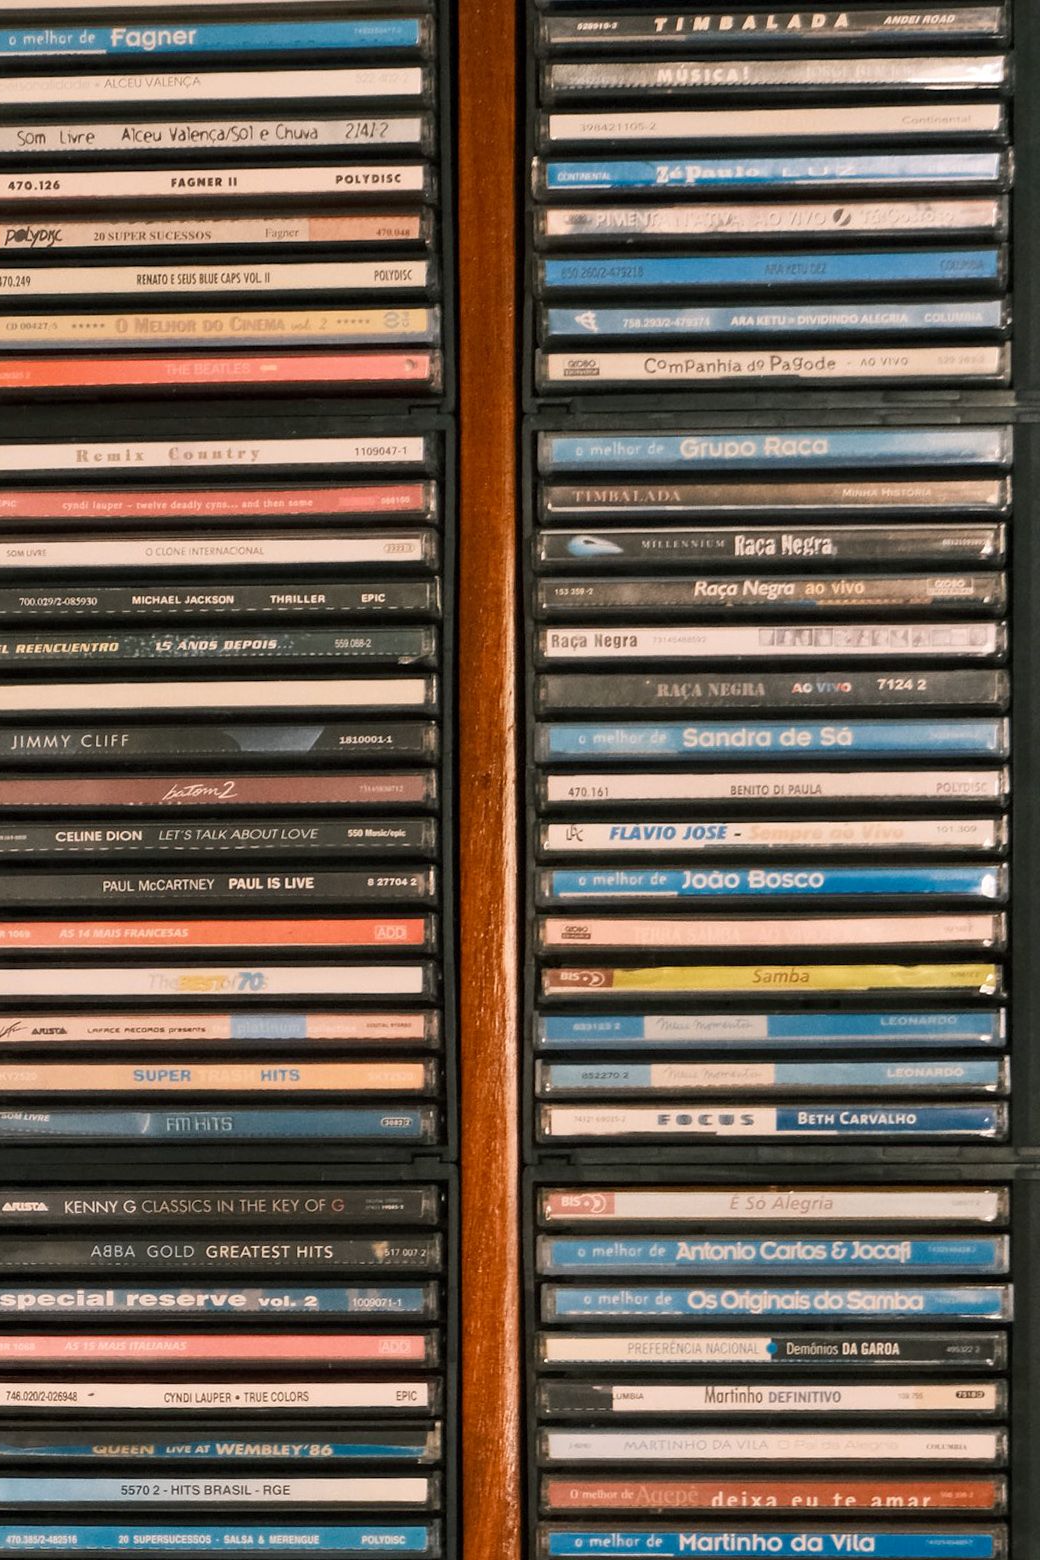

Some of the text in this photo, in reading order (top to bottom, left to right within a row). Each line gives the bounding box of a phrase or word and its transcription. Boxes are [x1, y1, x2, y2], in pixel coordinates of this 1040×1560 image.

[654, 13, 850, 31] TIMBALADA
[8, 27, 197, 52] o melhor de Fagner
[8, 173, 401, 191] 470.126 FAGNER II POLYDISC
[644, 355, 836, 374] Companhia do Pagode
[695, 579, 865, 598] Raça Negra ao vivo
[132, 593, 386, 605] MICHAEL JACKSON THRILLER EPIC
[12, 734, 128, 749] JIMMY CLIFF
[55, 828, 319, 842] CELINE DION LET'S TALK ABOUT LOVE
[752, 968, 809, 984] Samba
[798, 1111, 917, 1125] BETH CARVALHO
[147, 1245, 333, 1259] GOLD GREATEST HITS
[676, 1241, 826, 1260] Antonio Carlos
[0, 1291, 318, 1310] special reserve vol. 2
